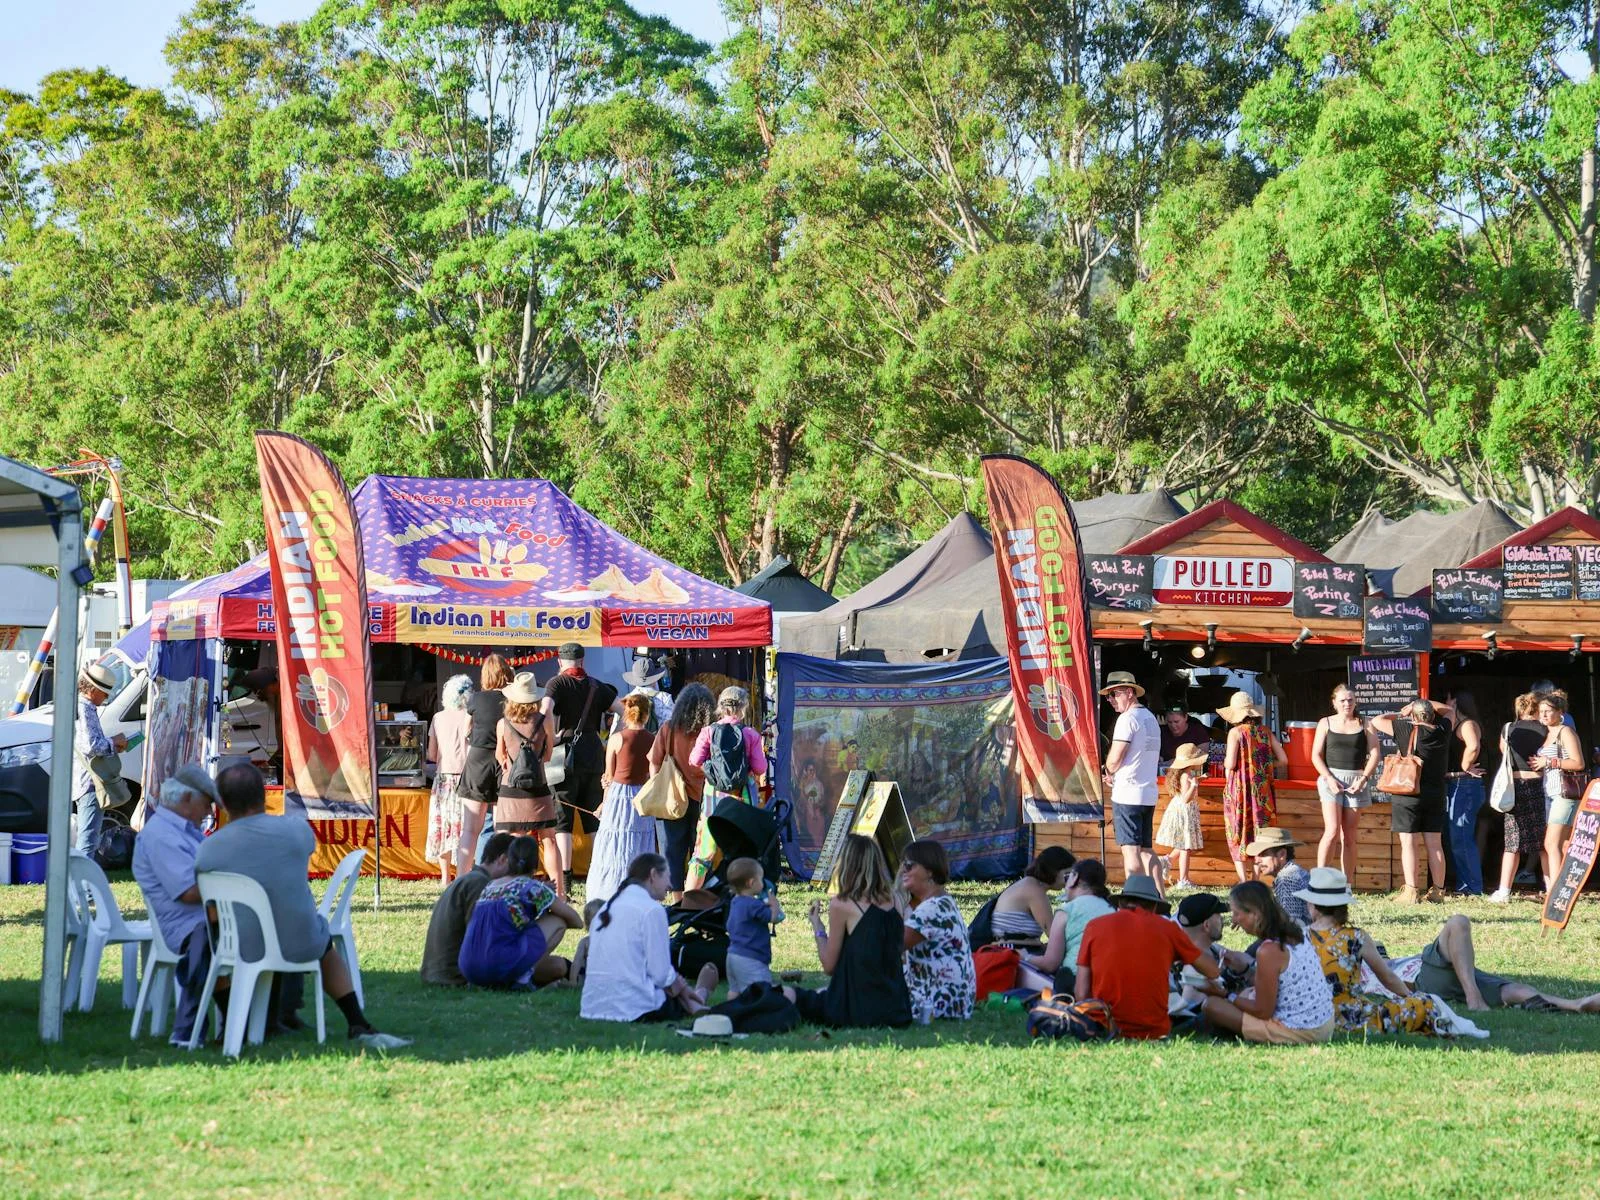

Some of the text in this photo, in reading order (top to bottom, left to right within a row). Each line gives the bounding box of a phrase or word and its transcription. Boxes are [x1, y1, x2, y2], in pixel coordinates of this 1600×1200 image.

[391, 491, 453, 506] SNACKS
[470, 496, 537, 507] CURRIES
[451, 517, 498, 534] Hot
[504, 522, 567, 547] Food
[309, 488, 346, 659] HOT FOOD
[1091, 560, 1145, 576] Pulled Pork
[1173, 559, 1272, 588] PULLED
[1301, 567, 1356, 582] Pulled Pork
[279, 511, 318, 660] INDIAN
[1034, 505, 1073, 669] HOT FOOD
[1090, 578, 1140, 597] Burger
[1436, 571, 1462, 589] Pulled
[1006, 528, 1049, 671] INDIAN
[1195, 592, 1250, 604] KITCHEN
[1302, 586, 1352, 603] Poutine
[411, 606, 591, 631] Indian Hot Food
[621, 612, 733, 627] VEGETARIAN
[1369, 602, 1430, 620] Fried Chicken
[646, 627, 709, 641] VEGAN
[308, 814, 411, 848] NDIAN
